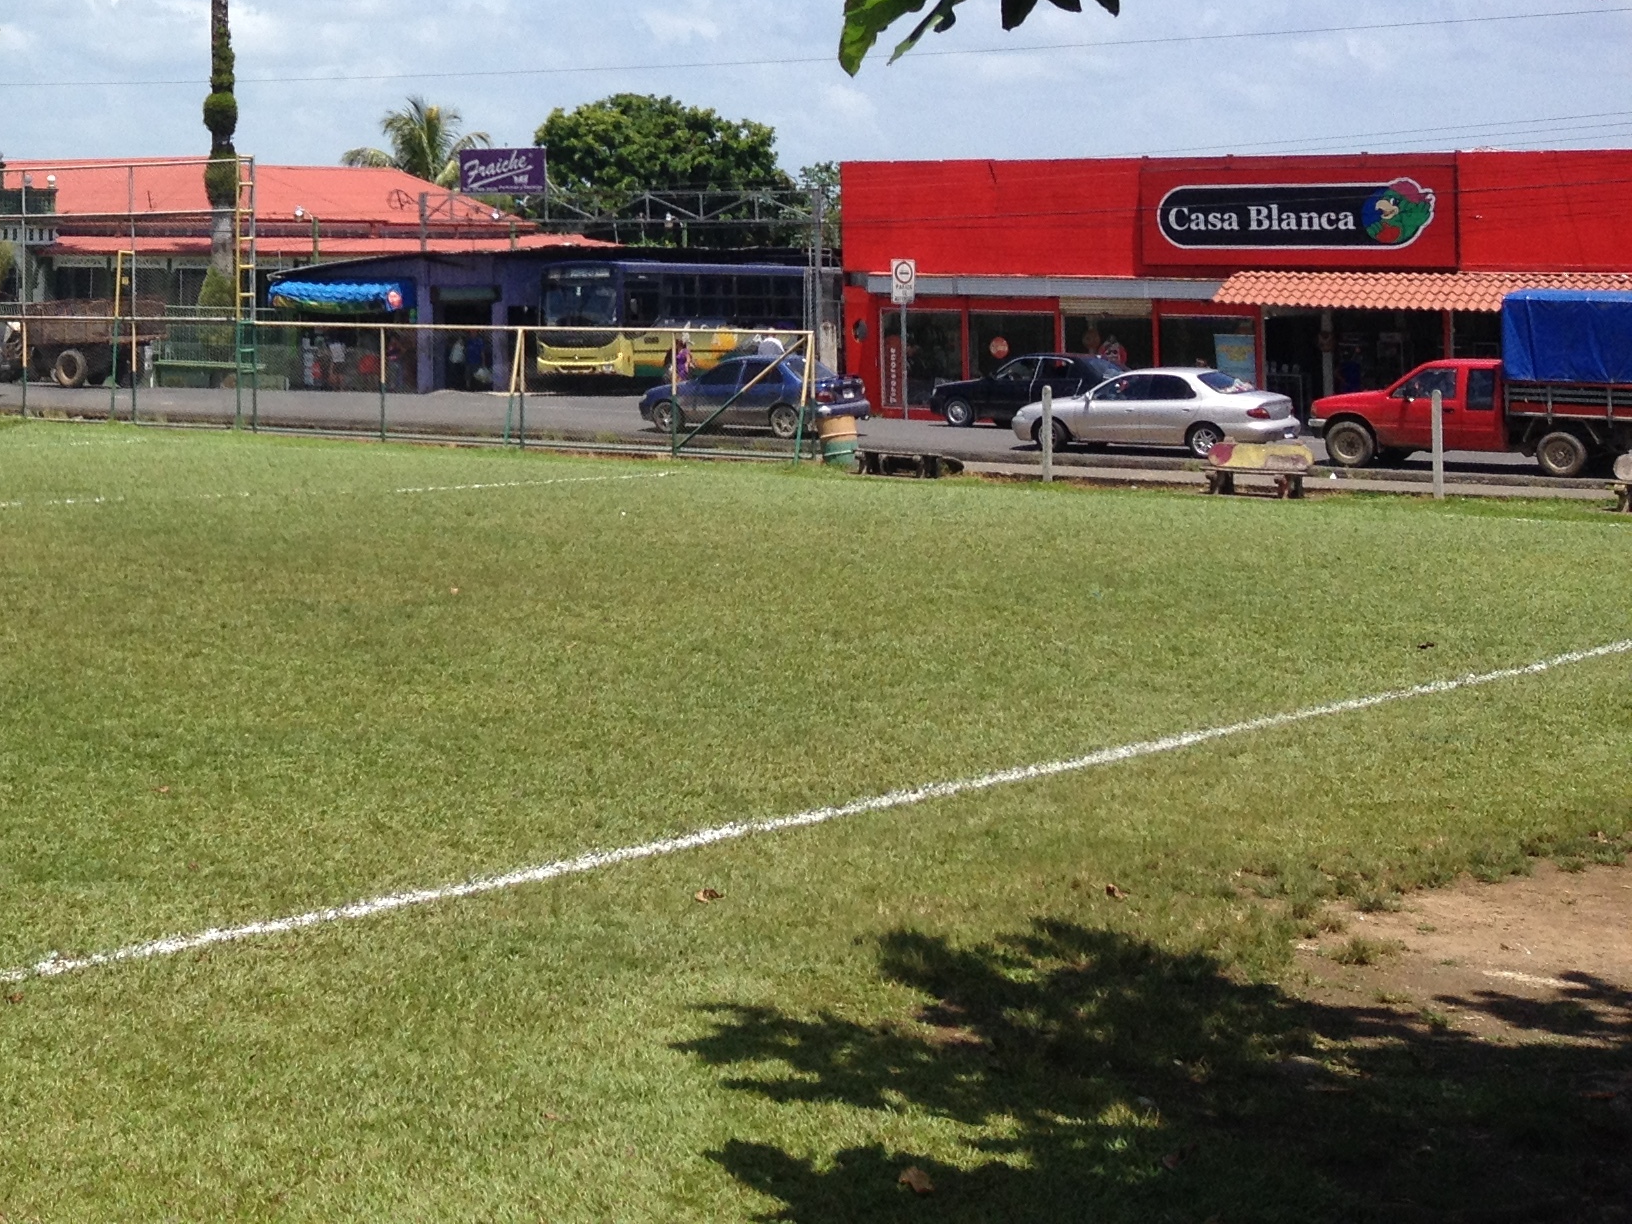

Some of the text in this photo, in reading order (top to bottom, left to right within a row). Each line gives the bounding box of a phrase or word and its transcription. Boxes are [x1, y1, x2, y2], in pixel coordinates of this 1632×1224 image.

[463, 150, 528, 185] Fraiche
[1168, 204, 1357, 231] Casa Blanca
